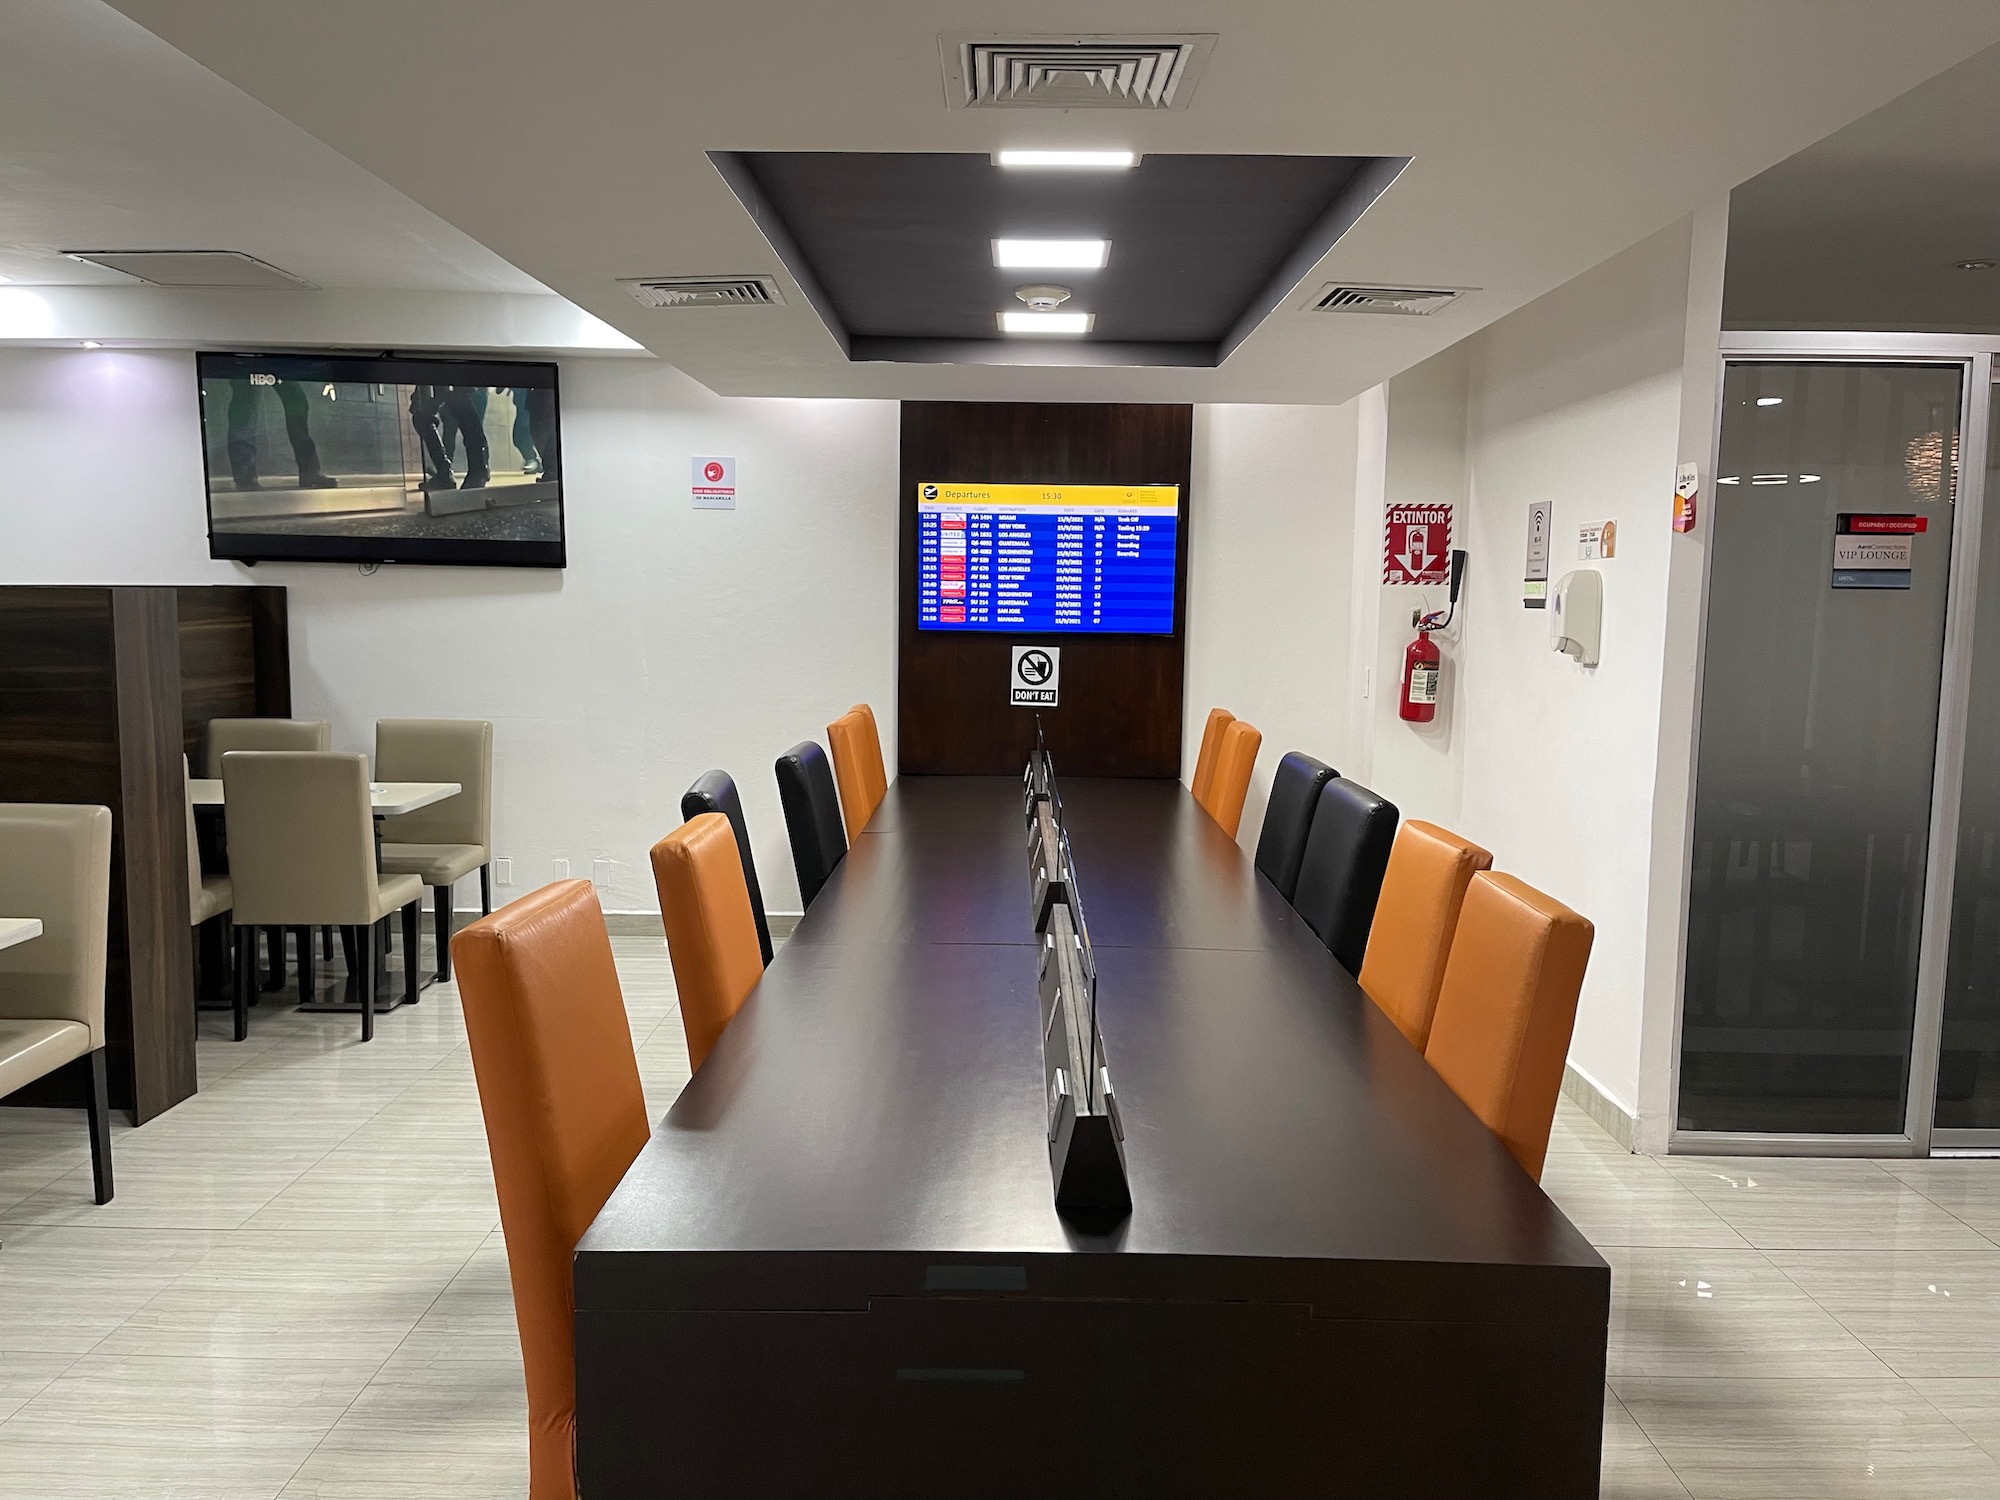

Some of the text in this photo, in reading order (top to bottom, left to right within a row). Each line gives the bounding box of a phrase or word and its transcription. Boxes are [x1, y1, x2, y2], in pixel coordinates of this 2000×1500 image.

[945, 490, 991, 499] Departures
[1042, 492, 1062, 500] 15:30
[1392, 510, 1446, 525] EXTINTOR
[1839, 551, 1907, 560] VIP LOUNGE
[1015, 690, 1054, 701] DON'T EAT
